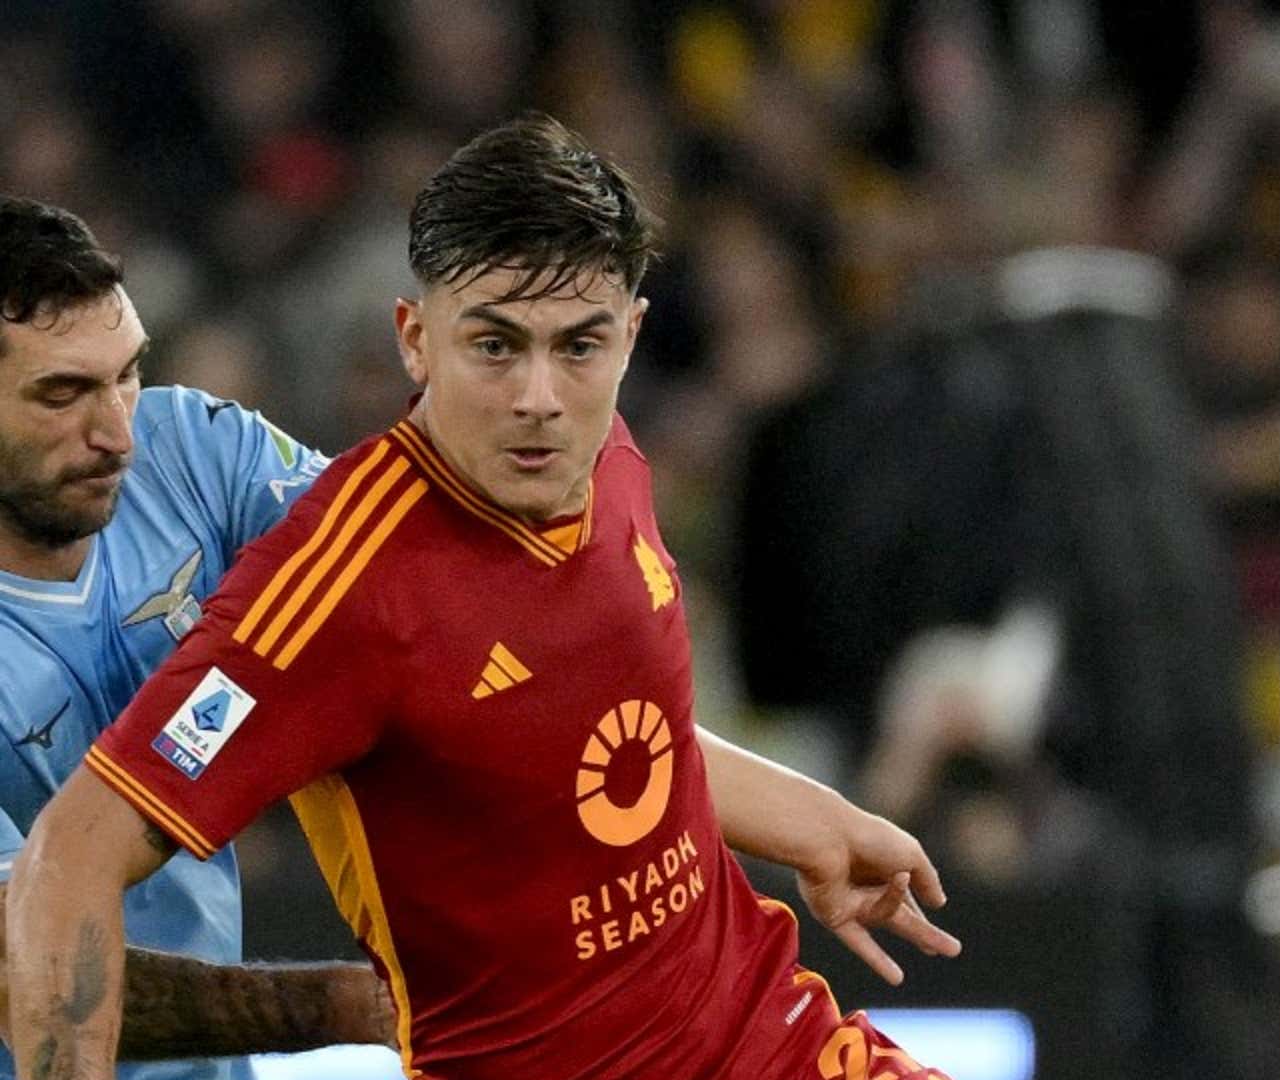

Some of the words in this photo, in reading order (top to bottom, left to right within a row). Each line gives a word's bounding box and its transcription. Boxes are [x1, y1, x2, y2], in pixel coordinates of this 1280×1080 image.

[171, 746, 198, 773] TIM
[570, 829, 699, 925] RIYADH
[575, 865, 705, 960] SEASON
